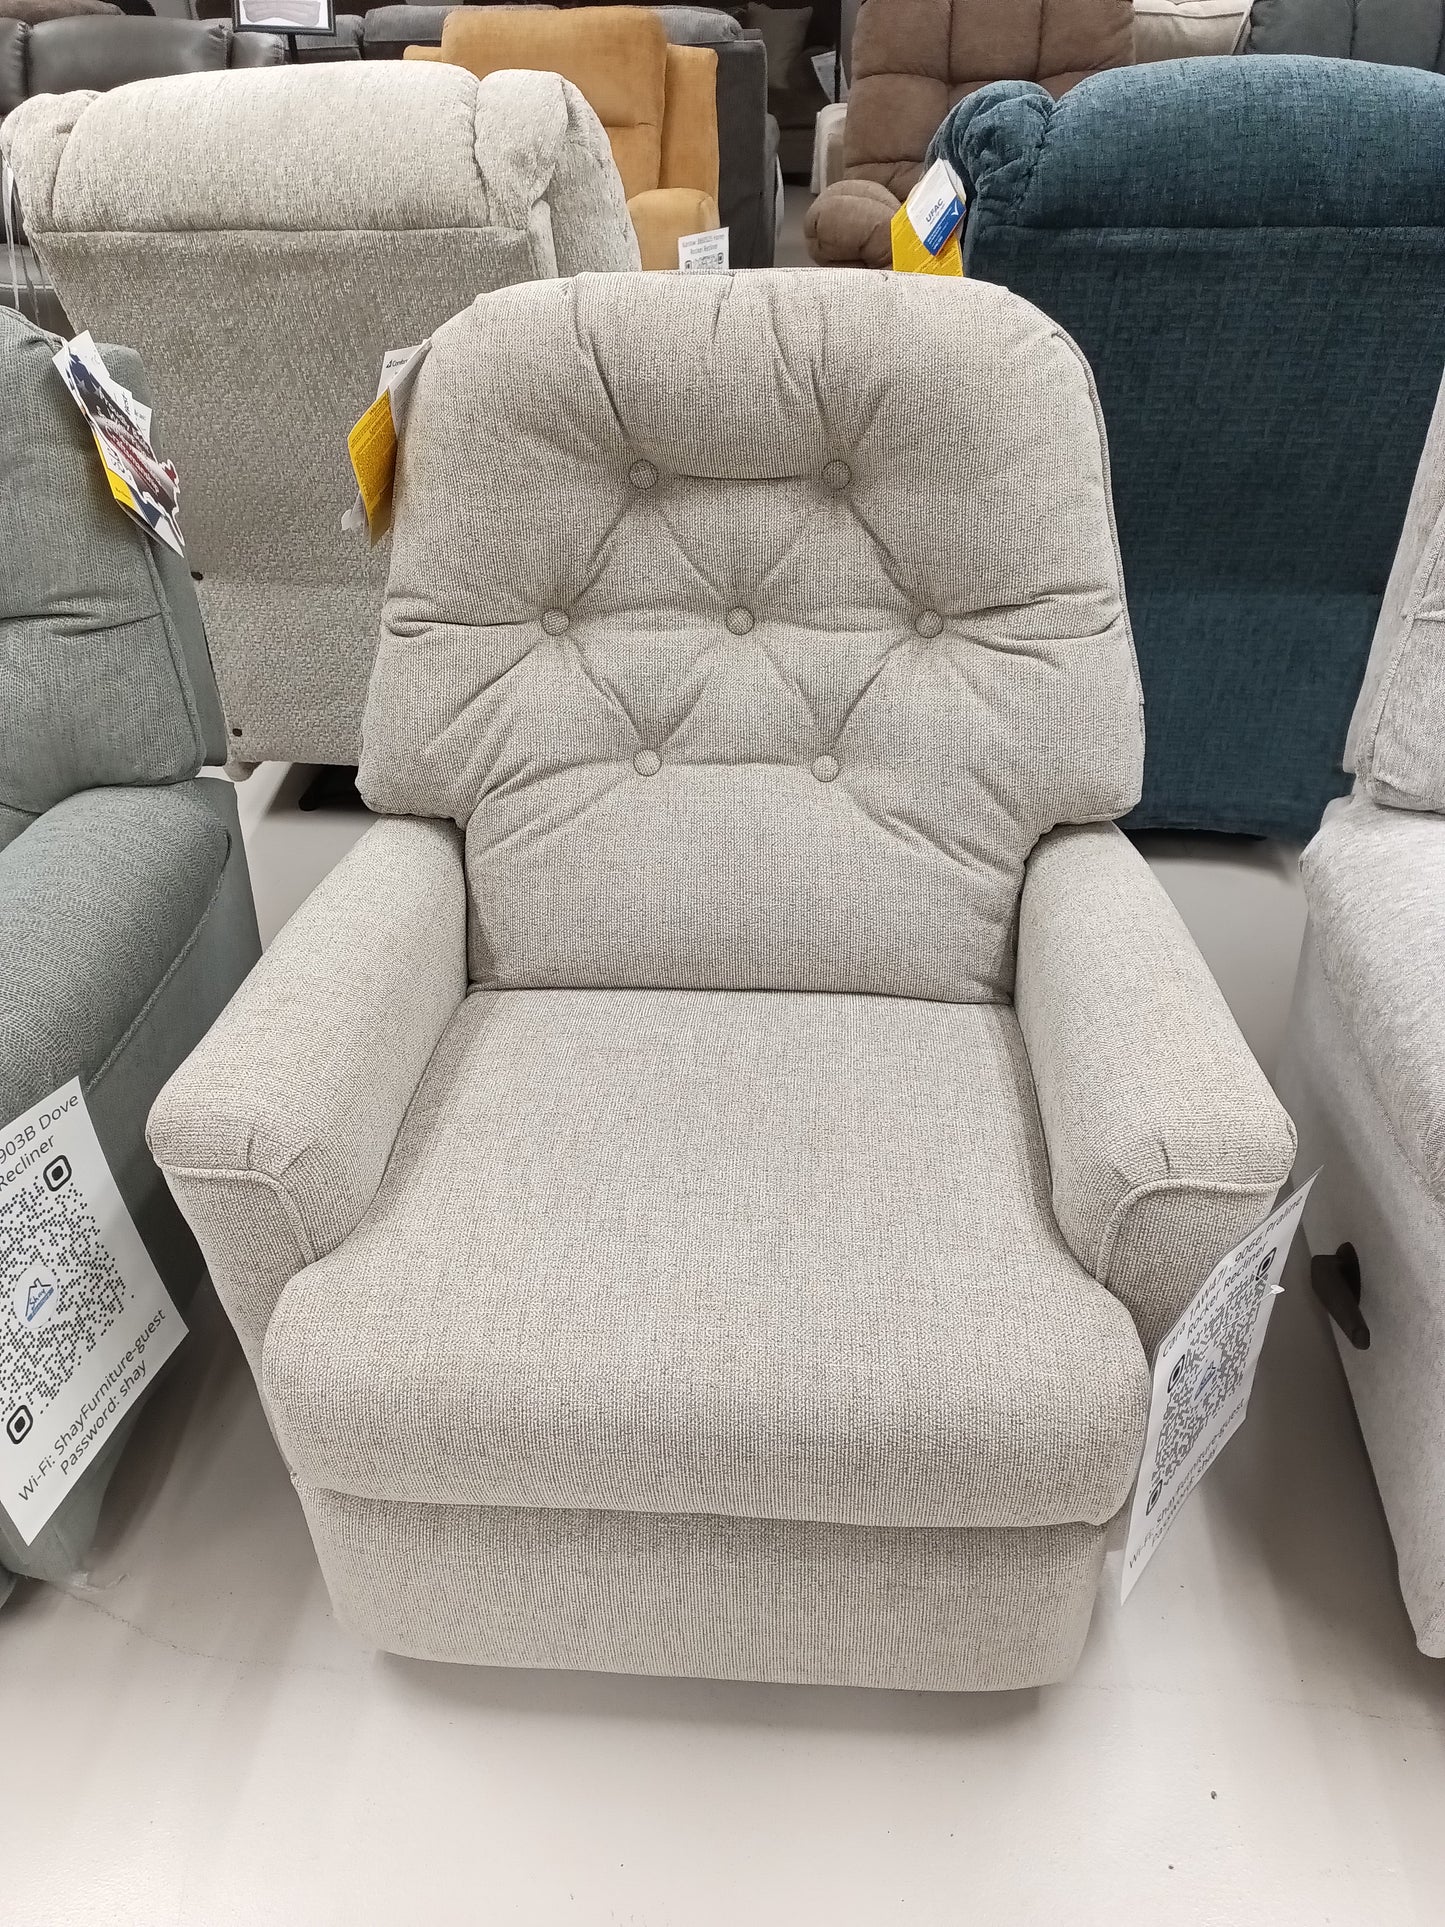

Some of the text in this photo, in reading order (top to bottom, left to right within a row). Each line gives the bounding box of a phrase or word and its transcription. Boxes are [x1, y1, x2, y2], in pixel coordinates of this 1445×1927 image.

[925, 198, 944, 222] UFAC
[38, 1095, 79, 1130] Dove
[0, 1135, 54, 1192] Recliner
[1223, 1241, 1269, 1292] Recliner
[1162, 1322, 1186, 1358] Cara
[18, 1309, 166, 1501] Wi-Fi: ShayFurniture-guest
[60, 1360, 147, 1475] Password: shay
